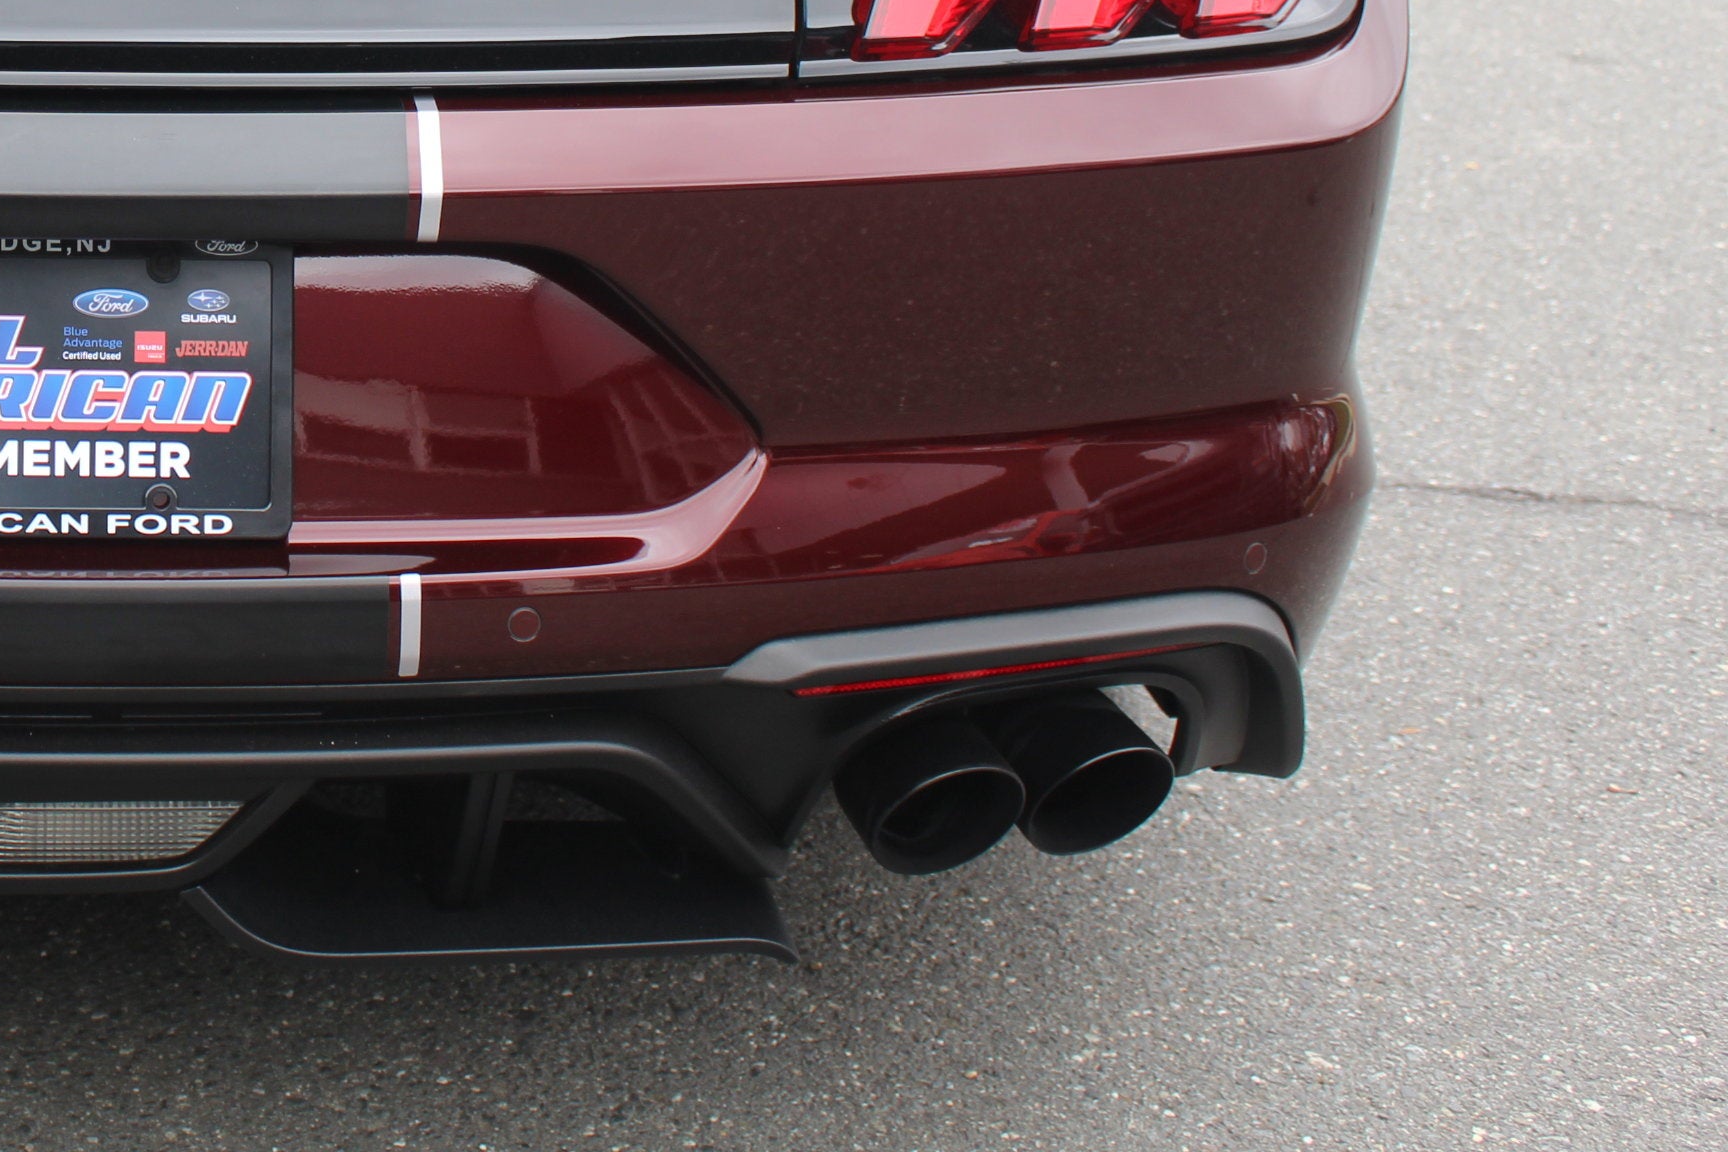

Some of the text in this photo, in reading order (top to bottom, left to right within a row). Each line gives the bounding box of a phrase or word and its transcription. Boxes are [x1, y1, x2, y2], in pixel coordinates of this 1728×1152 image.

[88, 291, 135, 313] Ford
[181, 314, 237, 324] SUBARU
[63, 327, 88, 336] Blue
[63, 338, 123, 350] Advantage
[62, 351, 122, 361] Certified Used
[107, 515, 234, 536] FORD
